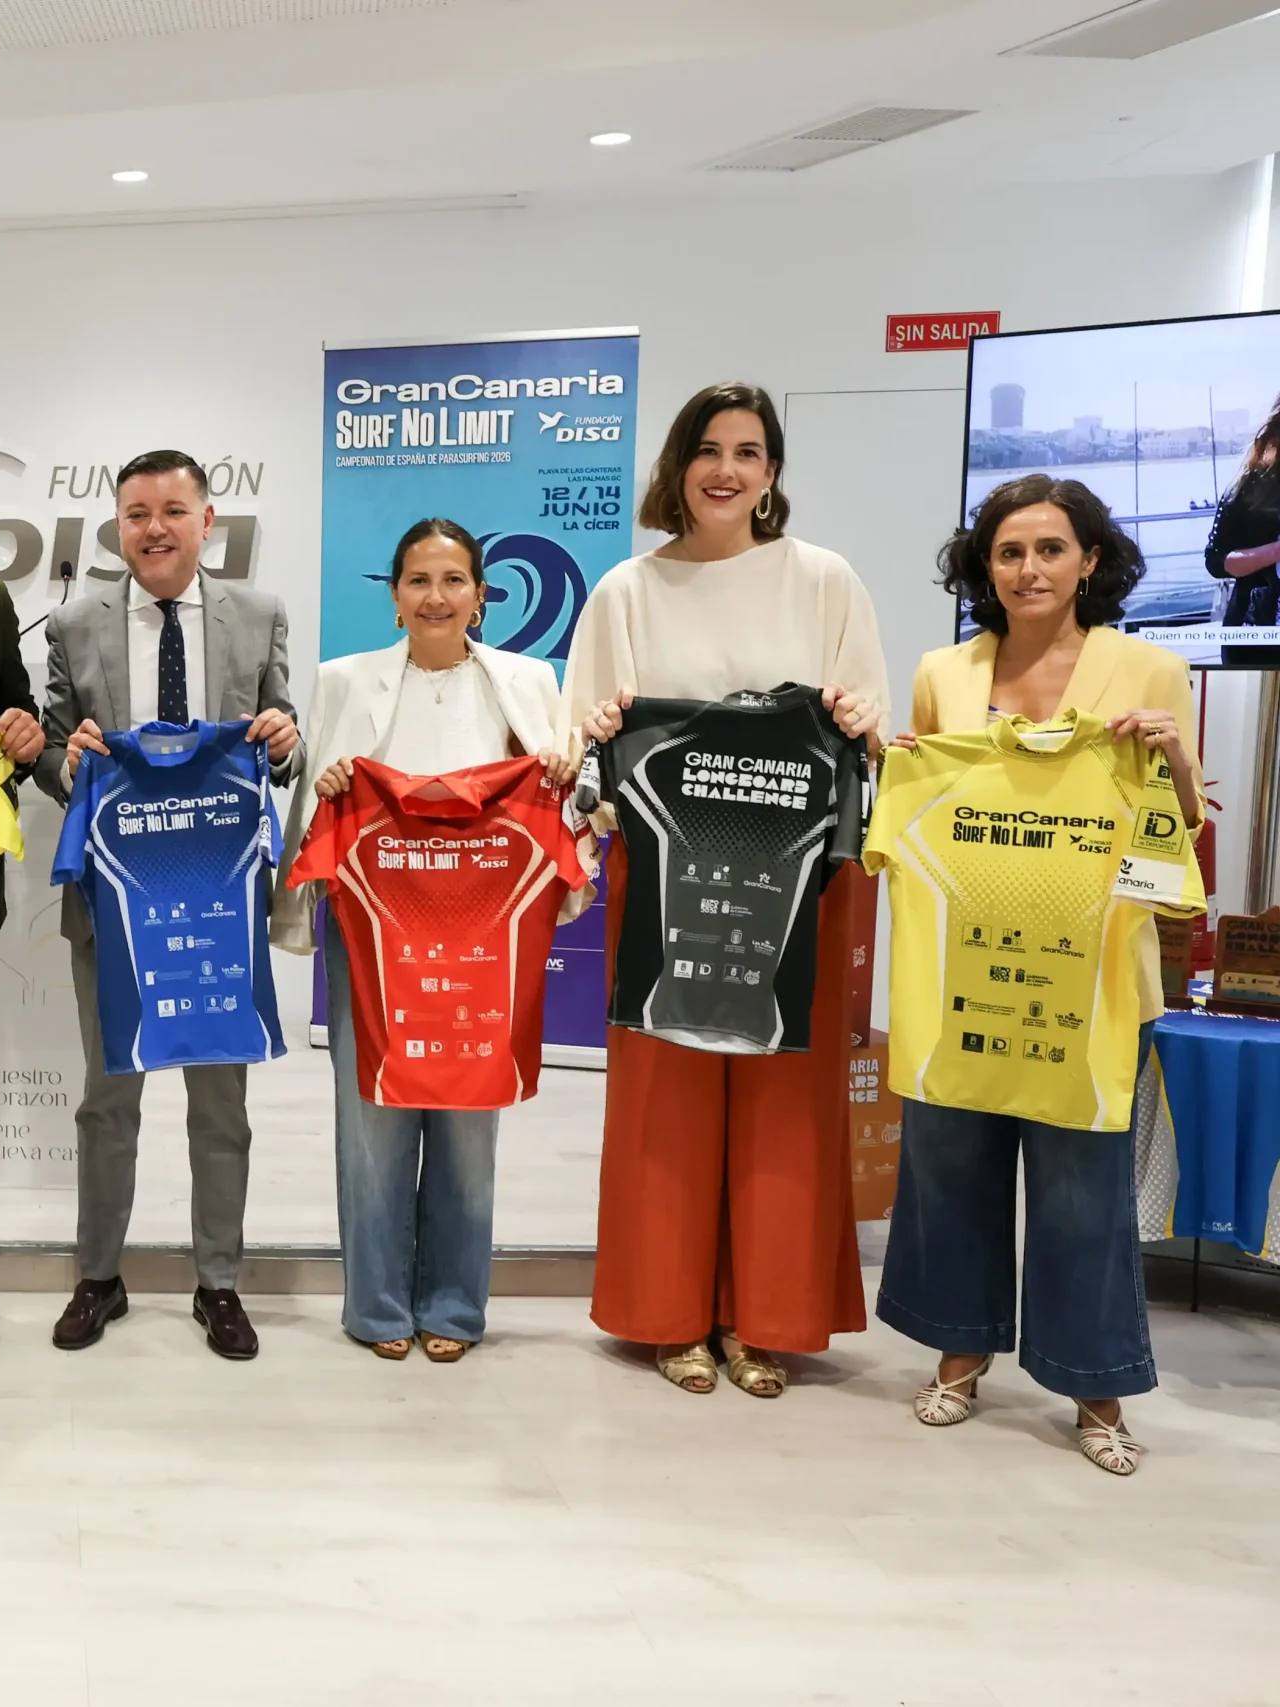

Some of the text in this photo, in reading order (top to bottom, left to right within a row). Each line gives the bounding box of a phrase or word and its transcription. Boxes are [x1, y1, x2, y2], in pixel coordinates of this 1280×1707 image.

[896, 322, 990, 341] SIN SALIDA
[336, 369, 624, 404] GranCanaria
[575, 414, 622, 424] FUNDACIÓN
[556, 426, 620, 442] DISA
[335, 451, 511, 467] CAMPEONATO DE ESPAÑA DE PARASURFING 2026
[48, 455, 264, 499] FUNÓN
[541, 486, 621, 501] 12 / 14
[539, 502, 621, 517] JUNIO
[563, 517, 620, 530] LA CÍCER
[1144, 631, 1181, 641] Quien
[1204, 631, 1216, 640] te
[1220, 630, 1259, 641] quiere
[685, 752, 811, 779] GRAN CANARIA
[682, 767, 809, 794] LONGBOARD
[116, 792, 239, 815] GranCanaria
[681, 783, 807, 810] CHALLENGE
[213, 816, 240, 826] DISA
[954, 806, 1115, 830] GranCanaria
[377, 835, 509, 849] GranCanaria
[1146, 841, 1174, 851] DEPORTES
[479, 860, 508, 868] DISA
[1118, 876, 1155, 890] anaria
[1040, 946, 1085, 959] GranCanaria
[849, 1058, 880, 1073] ARIA
